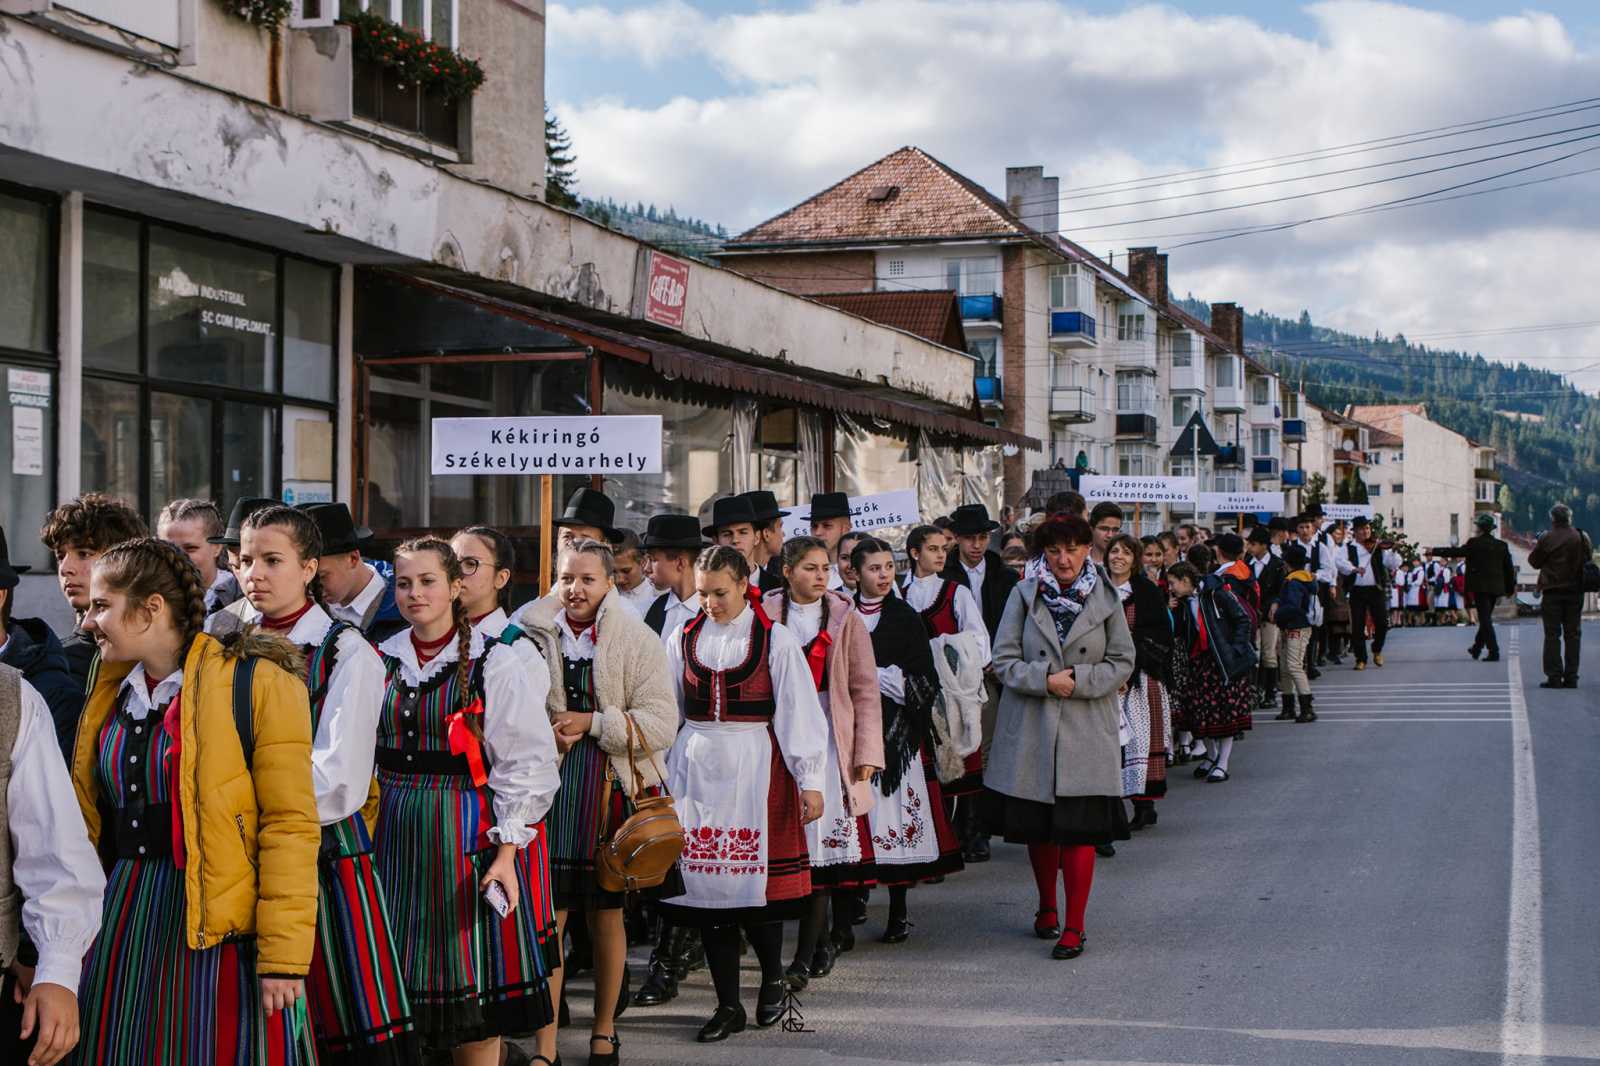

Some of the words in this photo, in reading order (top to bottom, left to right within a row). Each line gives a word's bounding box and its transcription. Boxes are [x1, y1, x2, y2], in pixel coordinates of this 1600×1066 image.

[201, 285, 246, 306] INDUSTRIAL
[202, 310, 214, 324] SC
[491, 427, 601, 448] Kékiringó
[445, 451, 648, 472] Székelyudvarhely
